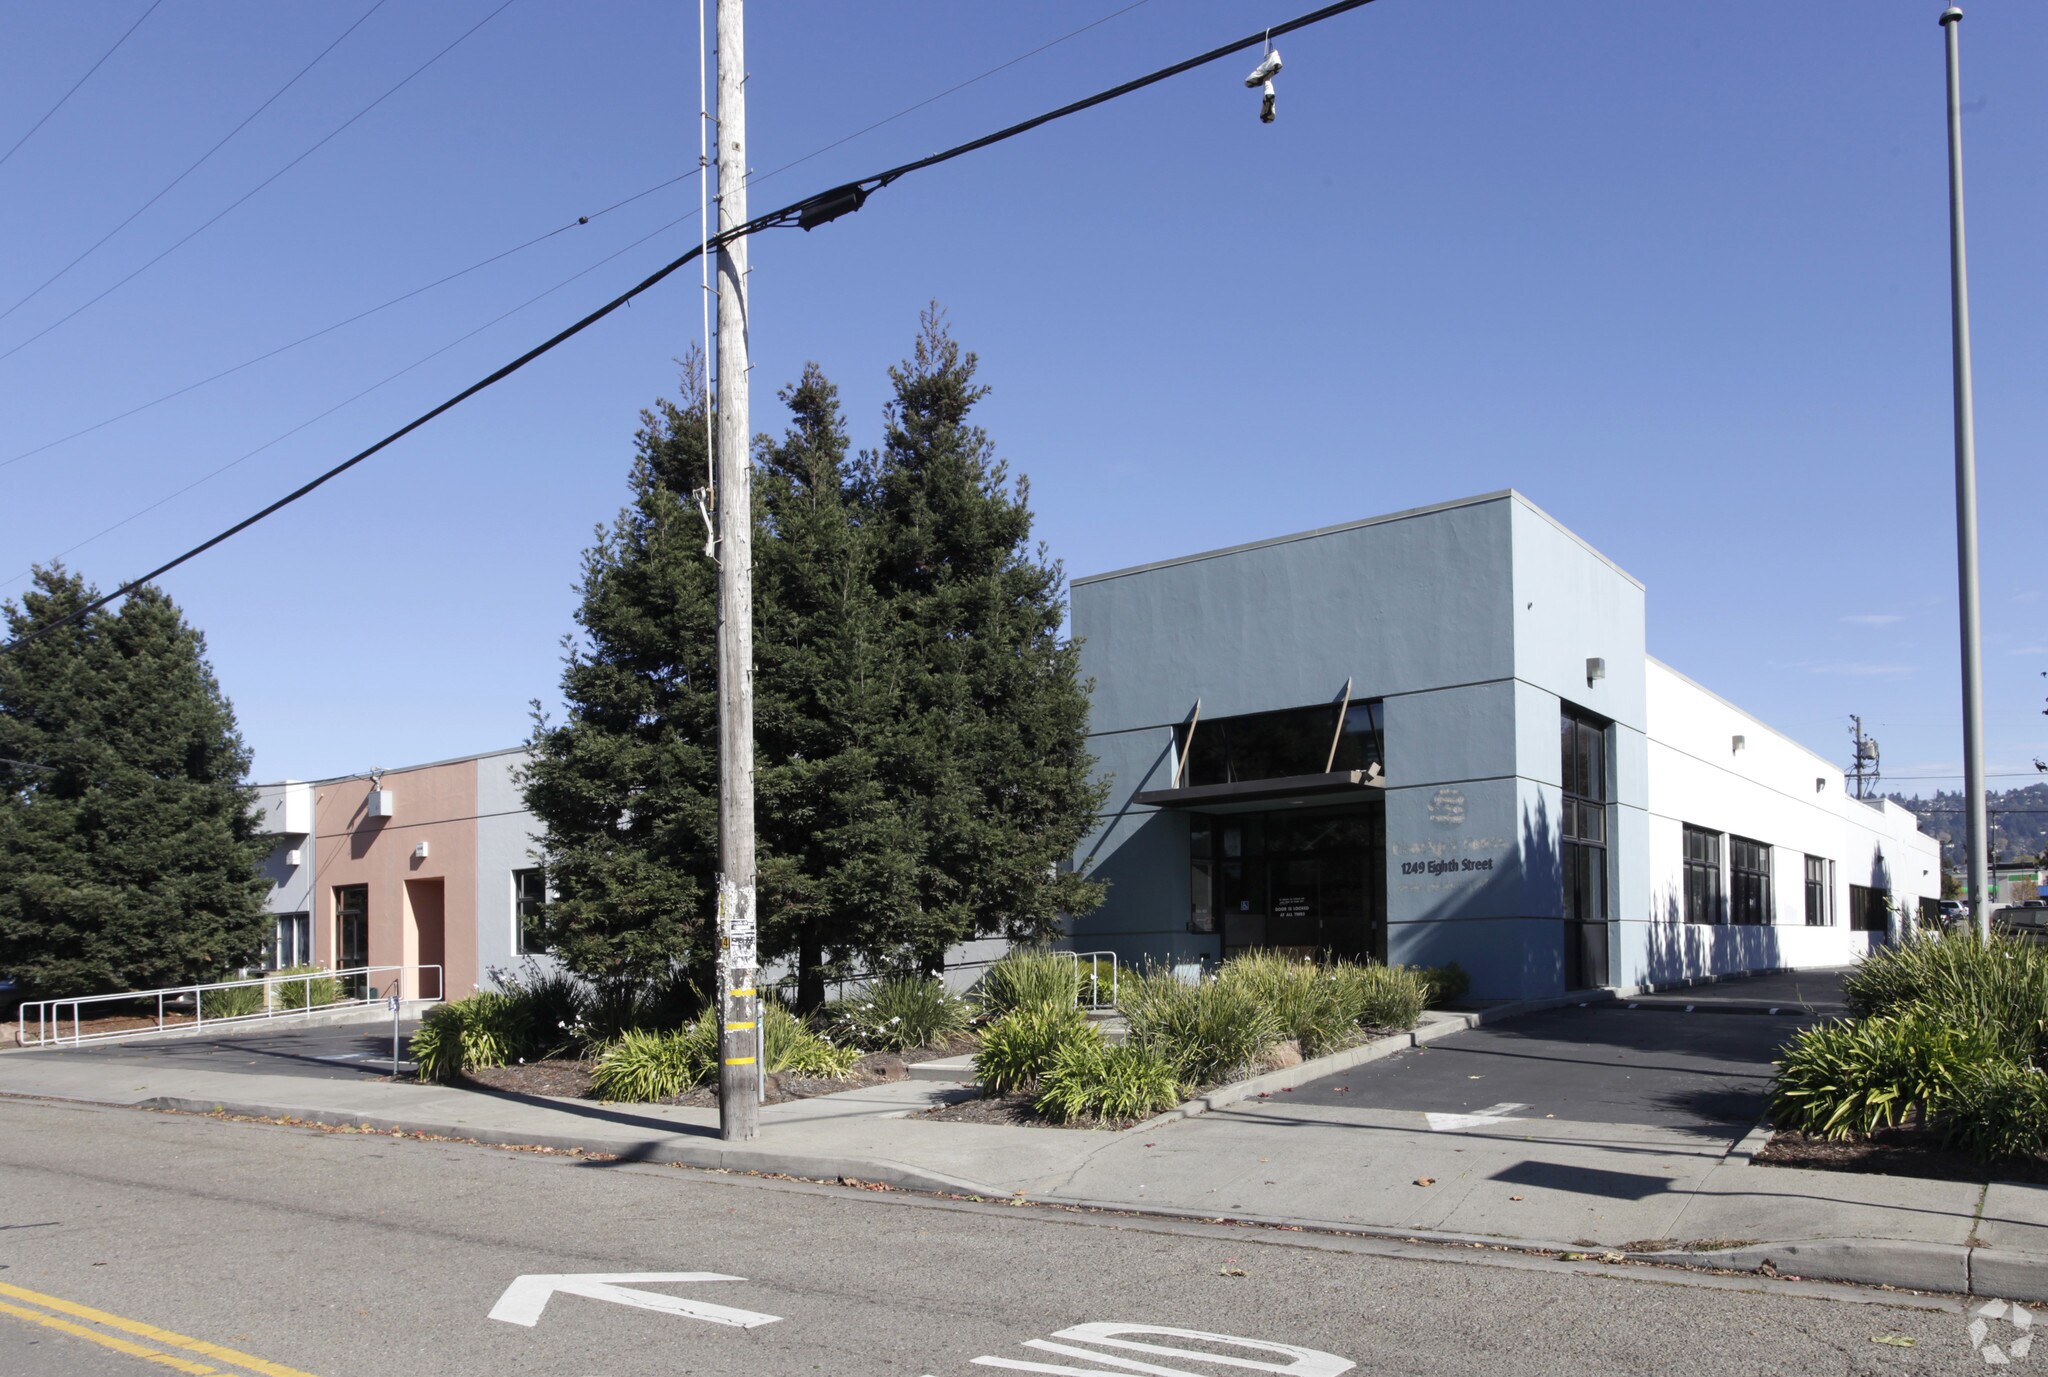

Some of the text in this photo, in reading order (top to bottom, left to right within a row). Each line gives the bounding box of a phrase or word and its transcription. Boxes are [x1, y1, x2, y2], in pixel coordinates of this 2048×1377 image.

[1401, 858, 1493, 876] 1249 Eighth Street
